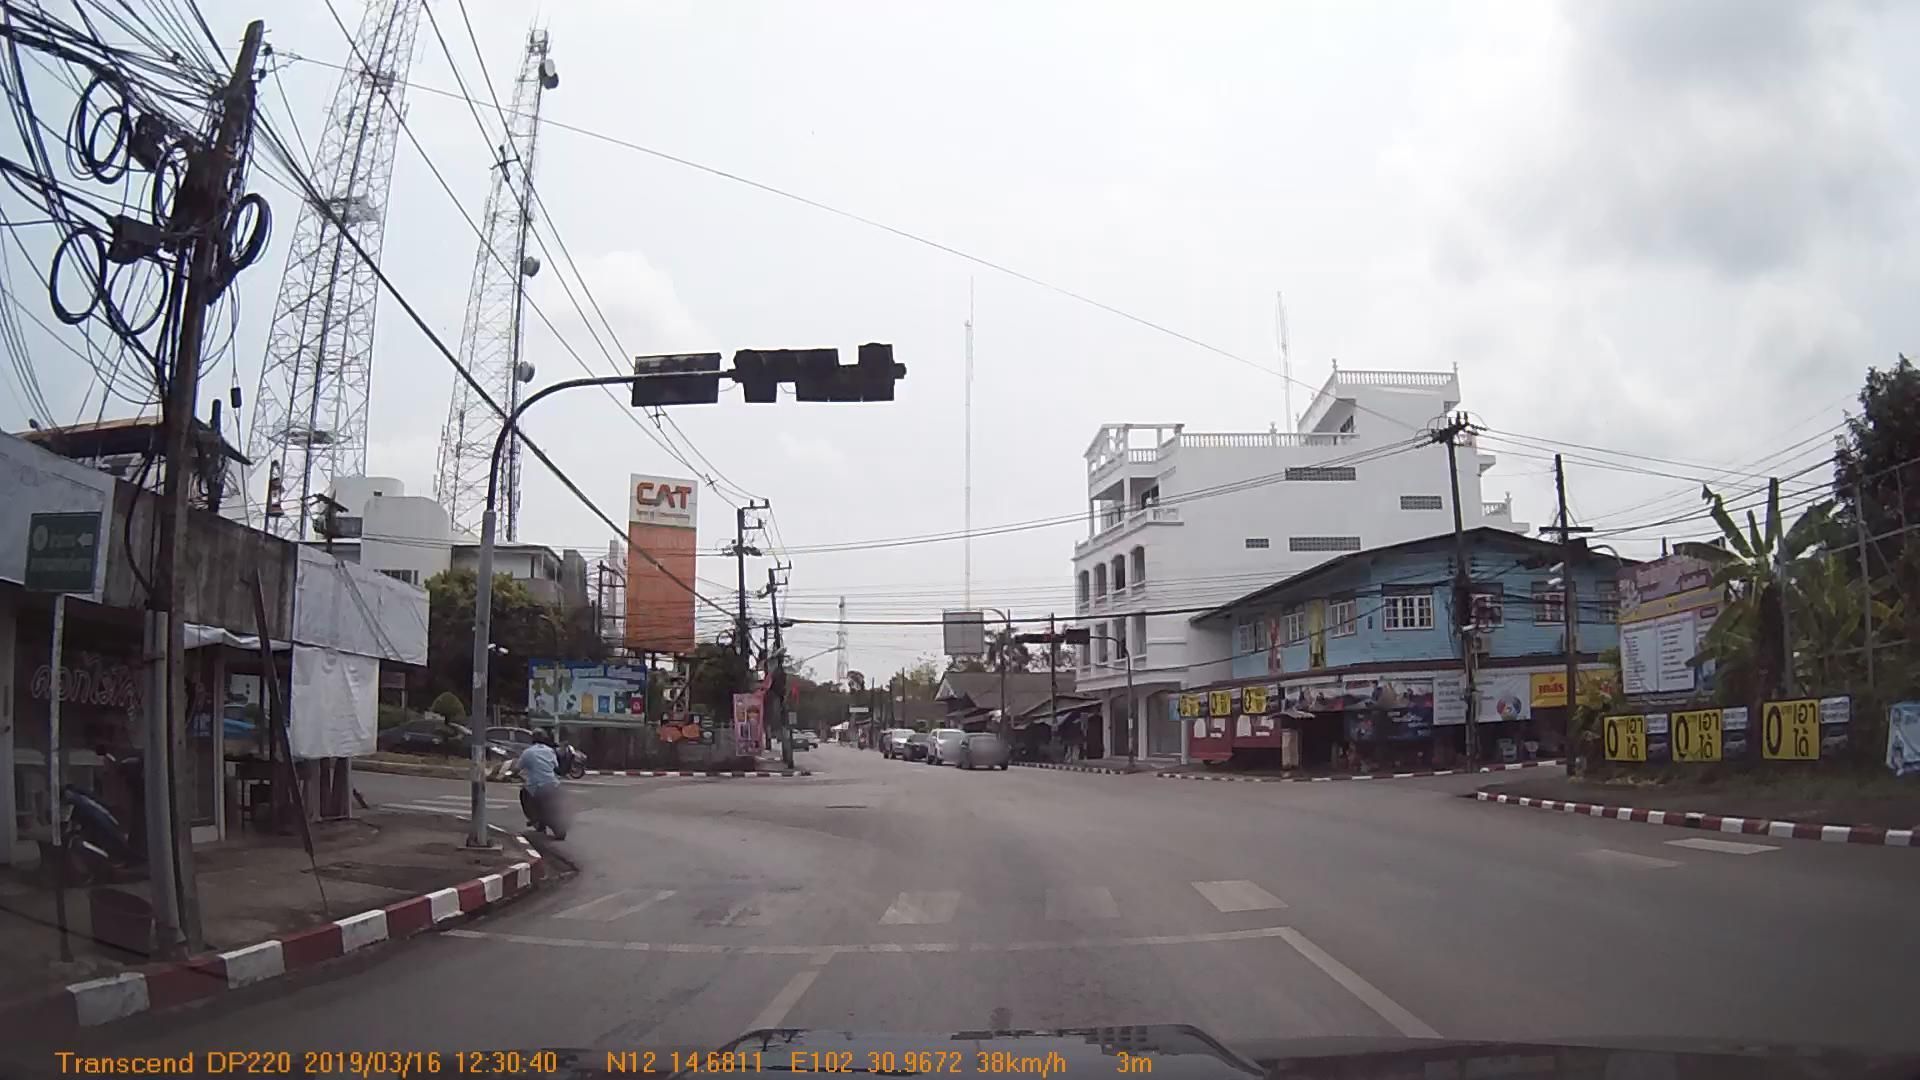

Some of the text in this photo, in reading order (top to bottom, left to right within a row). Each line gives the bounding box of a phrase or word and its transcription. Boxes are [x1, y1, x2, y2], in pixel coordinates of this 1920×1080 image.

[637, 482, 692, 509] CAT
[1607, 719, 1618, 757] 0
[1675, 715, 1689, 757] 0
[1766, 705, 1782, 755] 0
